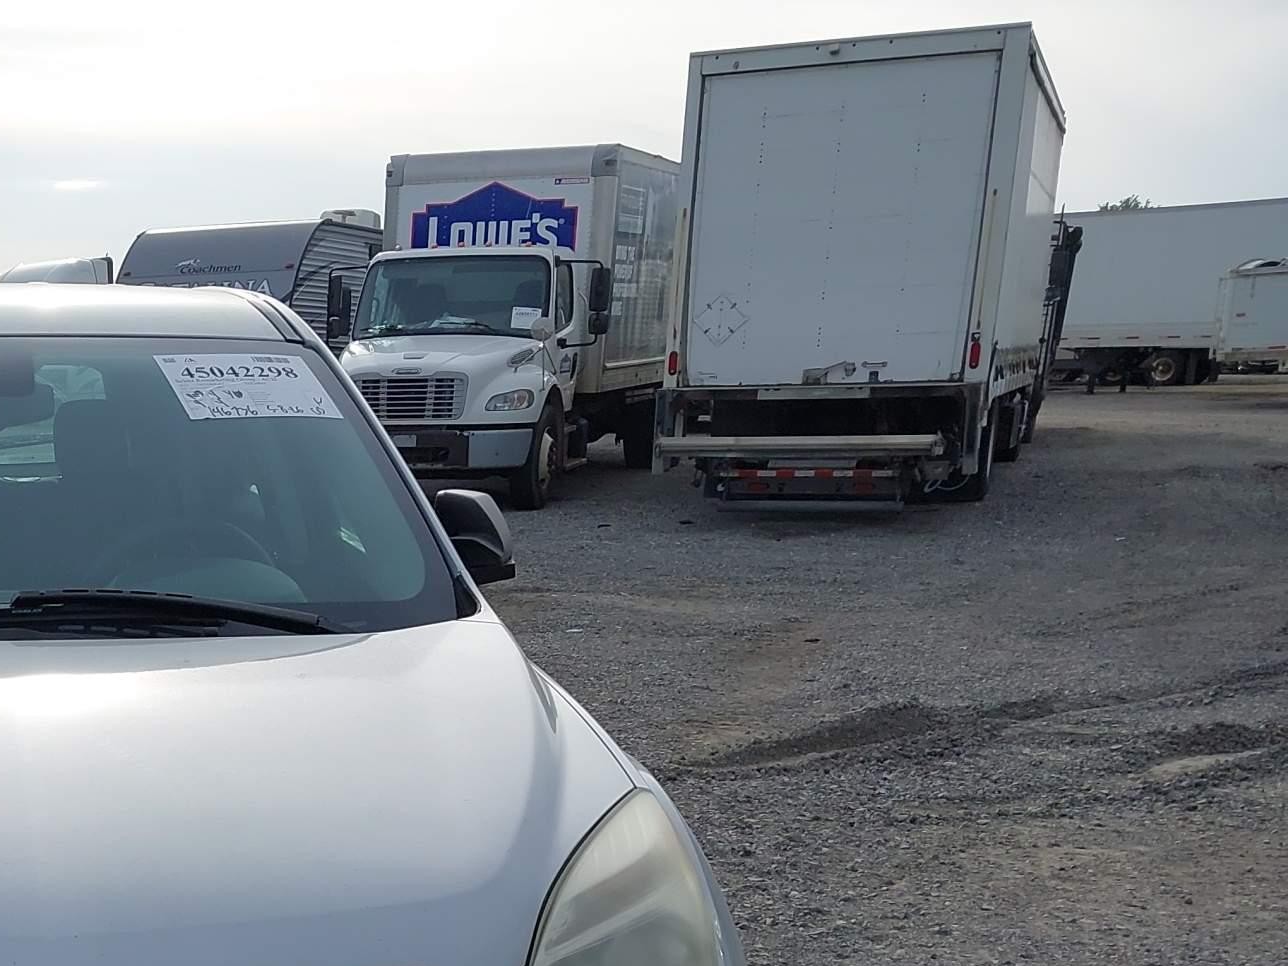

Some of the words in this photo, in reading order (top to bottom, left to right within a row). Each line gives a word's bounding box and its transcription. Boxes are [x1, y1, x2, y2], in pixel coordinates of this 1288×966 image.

[427, 213, 559, 249] LOWE'S
[179, 264, 242, 274] Coachmen
[180, 365, 299, 379] 45042298
